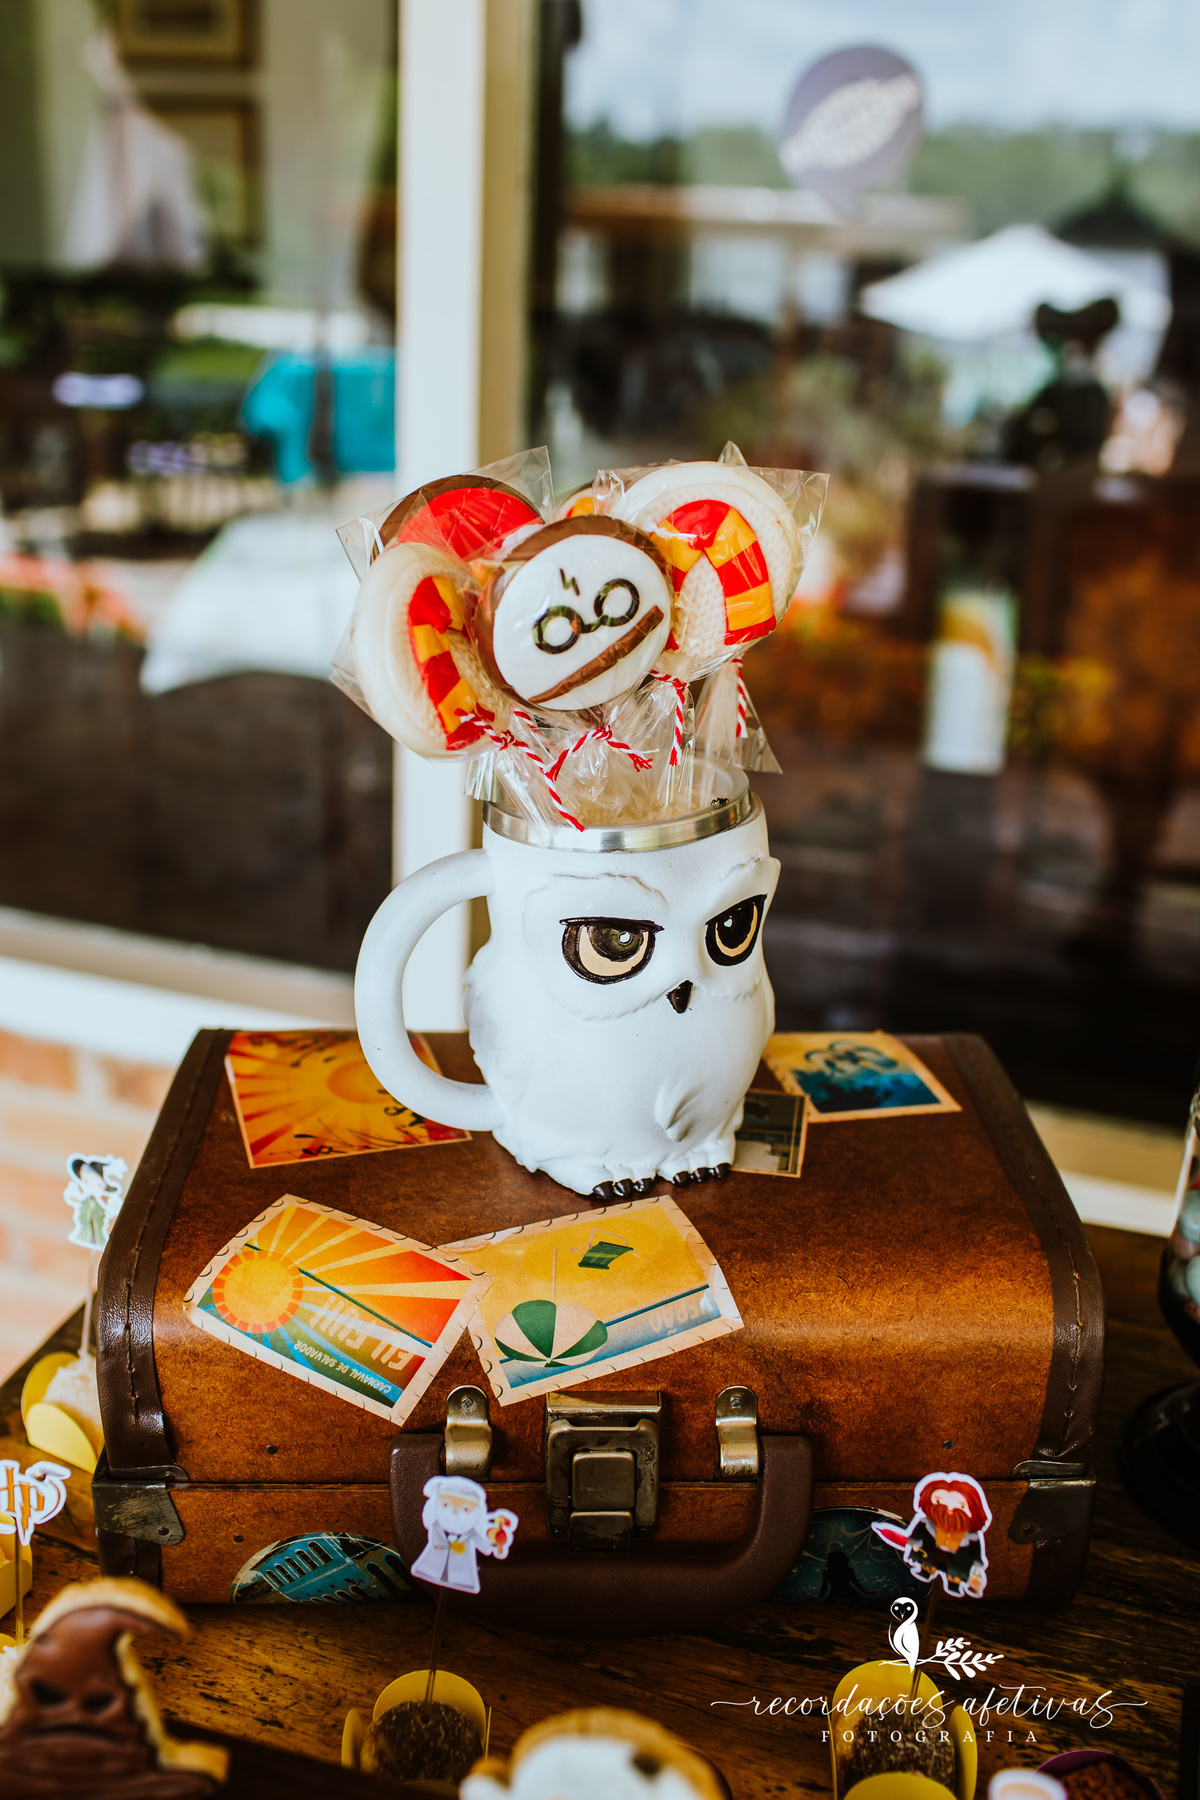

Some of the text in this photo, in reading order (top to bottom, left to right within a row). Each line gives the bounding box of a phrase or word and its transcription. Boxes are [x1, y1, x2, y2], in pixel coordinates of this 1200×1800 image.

[293, 1339, 392, 1394] CARNAVAL DE SALVADOR
